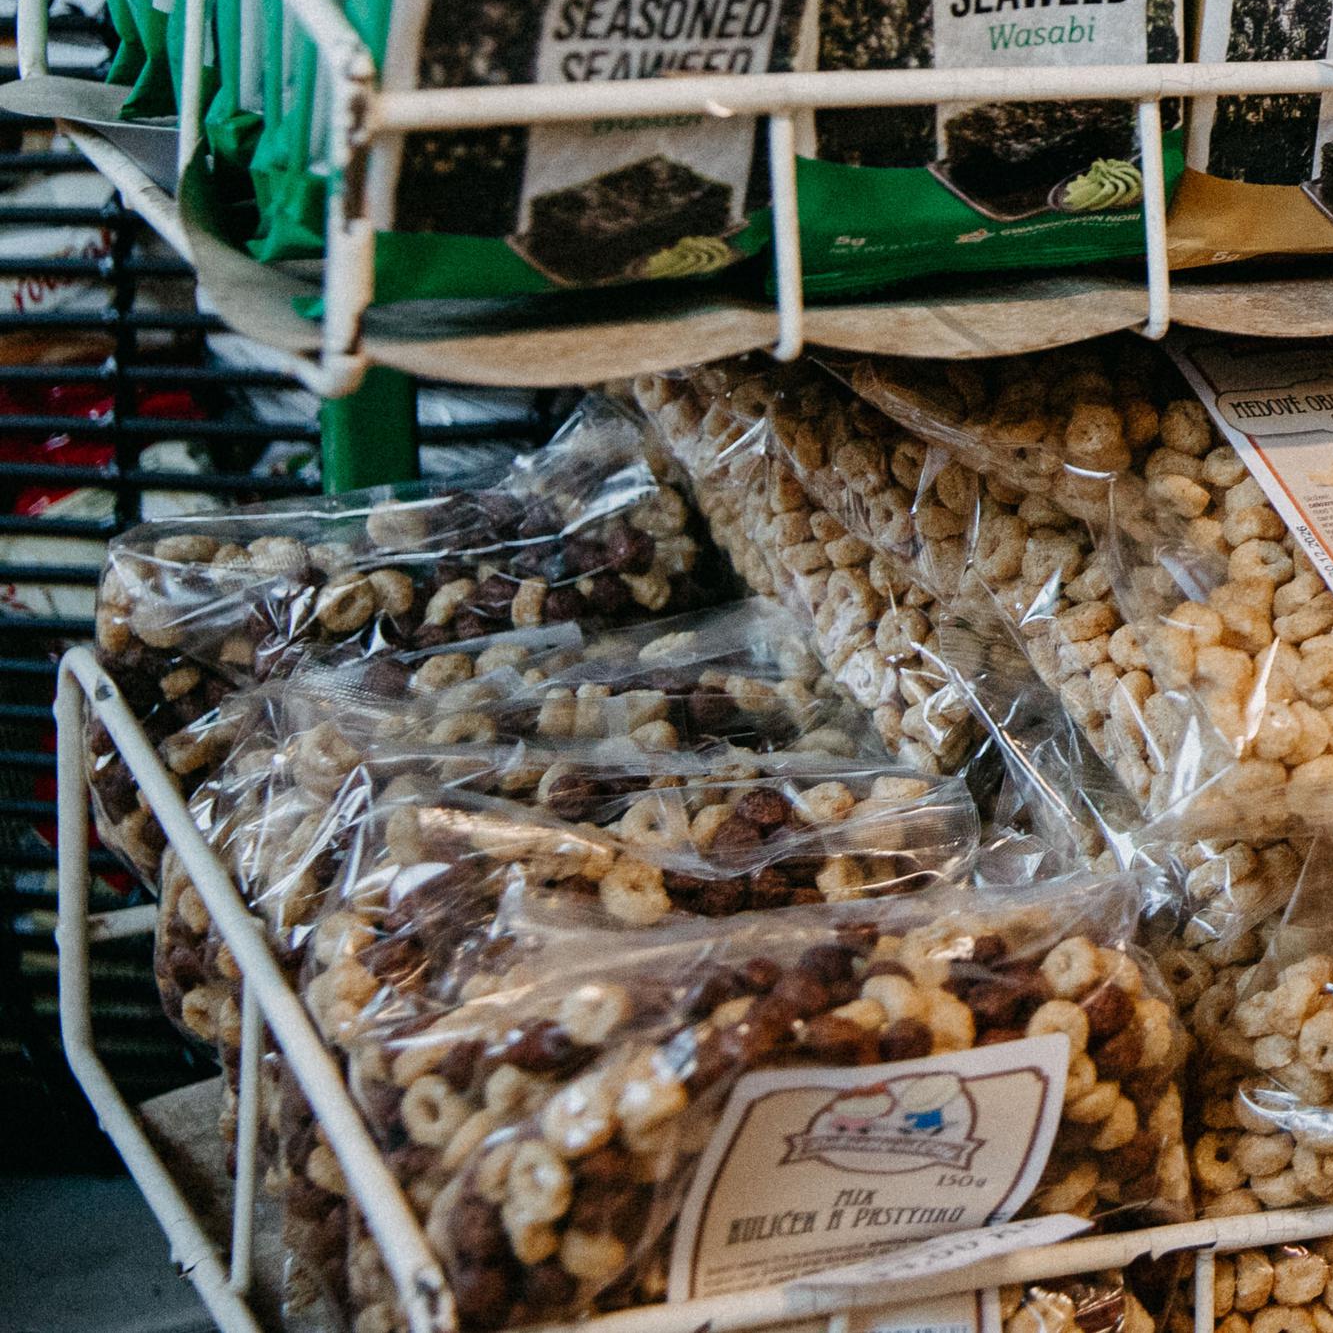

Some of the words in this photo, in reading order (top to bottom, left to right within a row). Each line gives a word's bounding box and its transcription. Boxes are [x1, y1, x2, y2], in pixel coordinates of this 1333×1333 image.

[987, 15, 1096, 52] Wasabi
[1228, 393, 1306, 418] MEDOVÉ
[936, 1172, 974, 1189] 150
